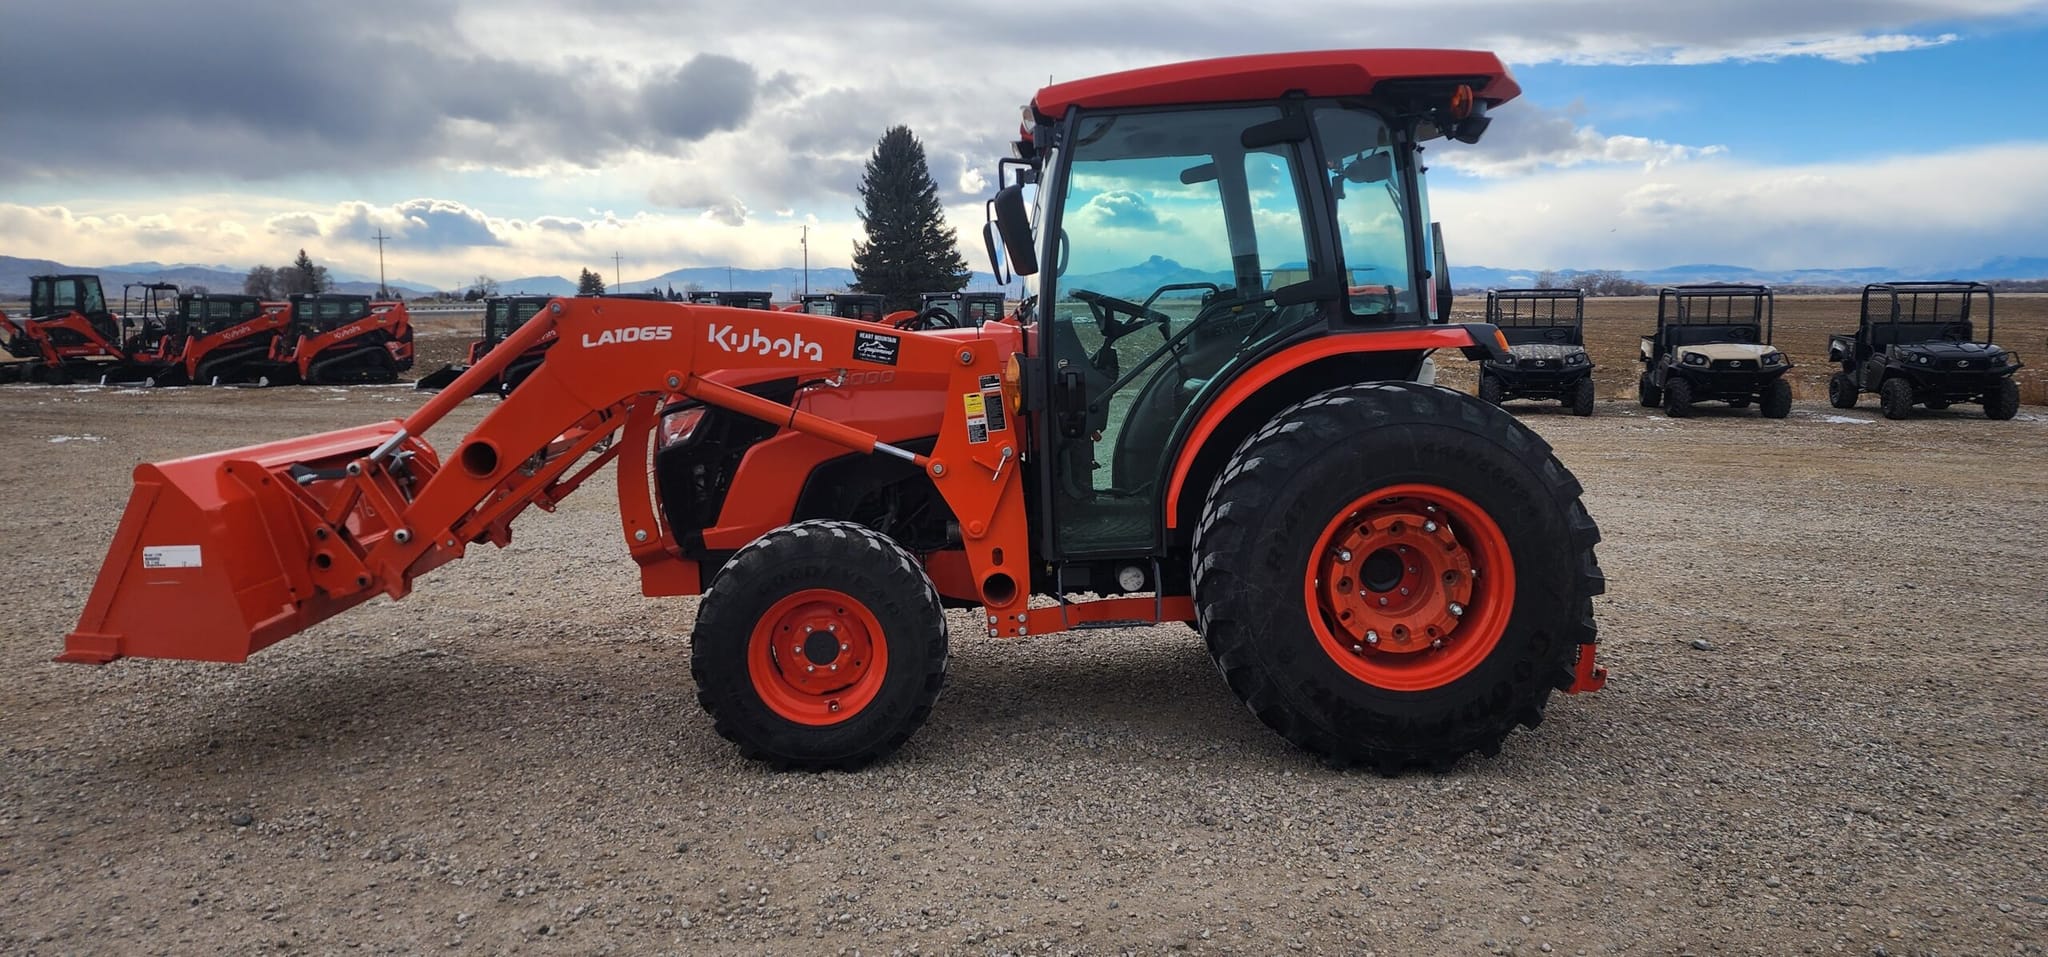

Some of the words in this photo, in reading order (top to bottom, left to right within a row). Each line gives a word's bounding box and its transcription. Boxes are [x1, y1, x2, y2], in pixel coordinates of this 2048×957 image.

[582, 326, 673, 348] LA1065
[708, 323, 823, 362] Kubota
[859, 332, 874, 340] HEART
[874, 334, 897, 343] MOUNTAIN
